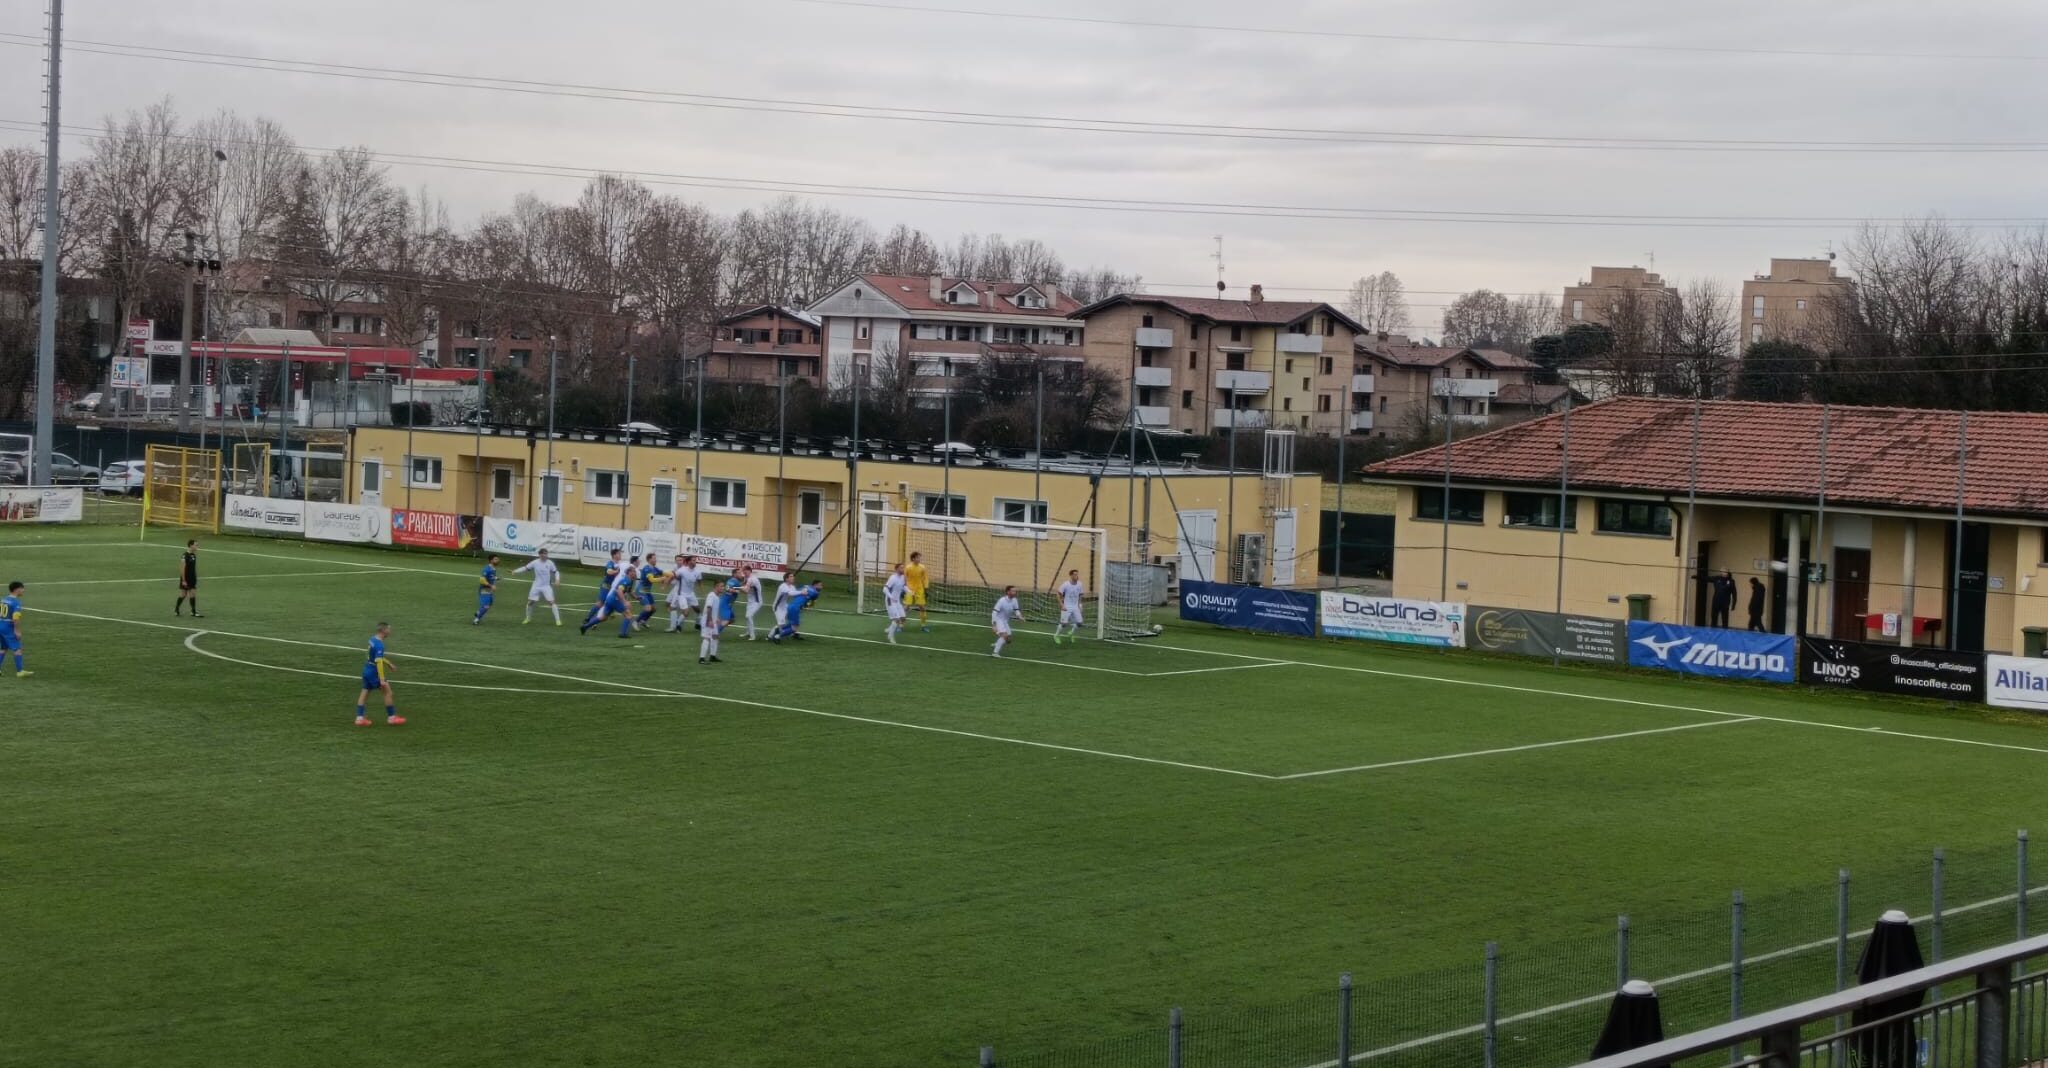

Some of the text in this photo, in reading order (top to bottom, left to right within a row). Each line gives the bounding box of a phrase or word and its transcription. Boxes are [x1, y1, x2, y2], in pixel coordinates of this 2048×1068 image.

[153, 344, 175, 352] MORO
[408, 512, 455, 537] PARATORI
[582, 535, 625, 554] Allianz
[1202, 594, 1238, 607] QUALITY
[1343, 597, 1437, 621] baldina
[1813, 661, 1861, 679] LINO'S
[1894, 675, 1972, 692] linoscoffee.com
